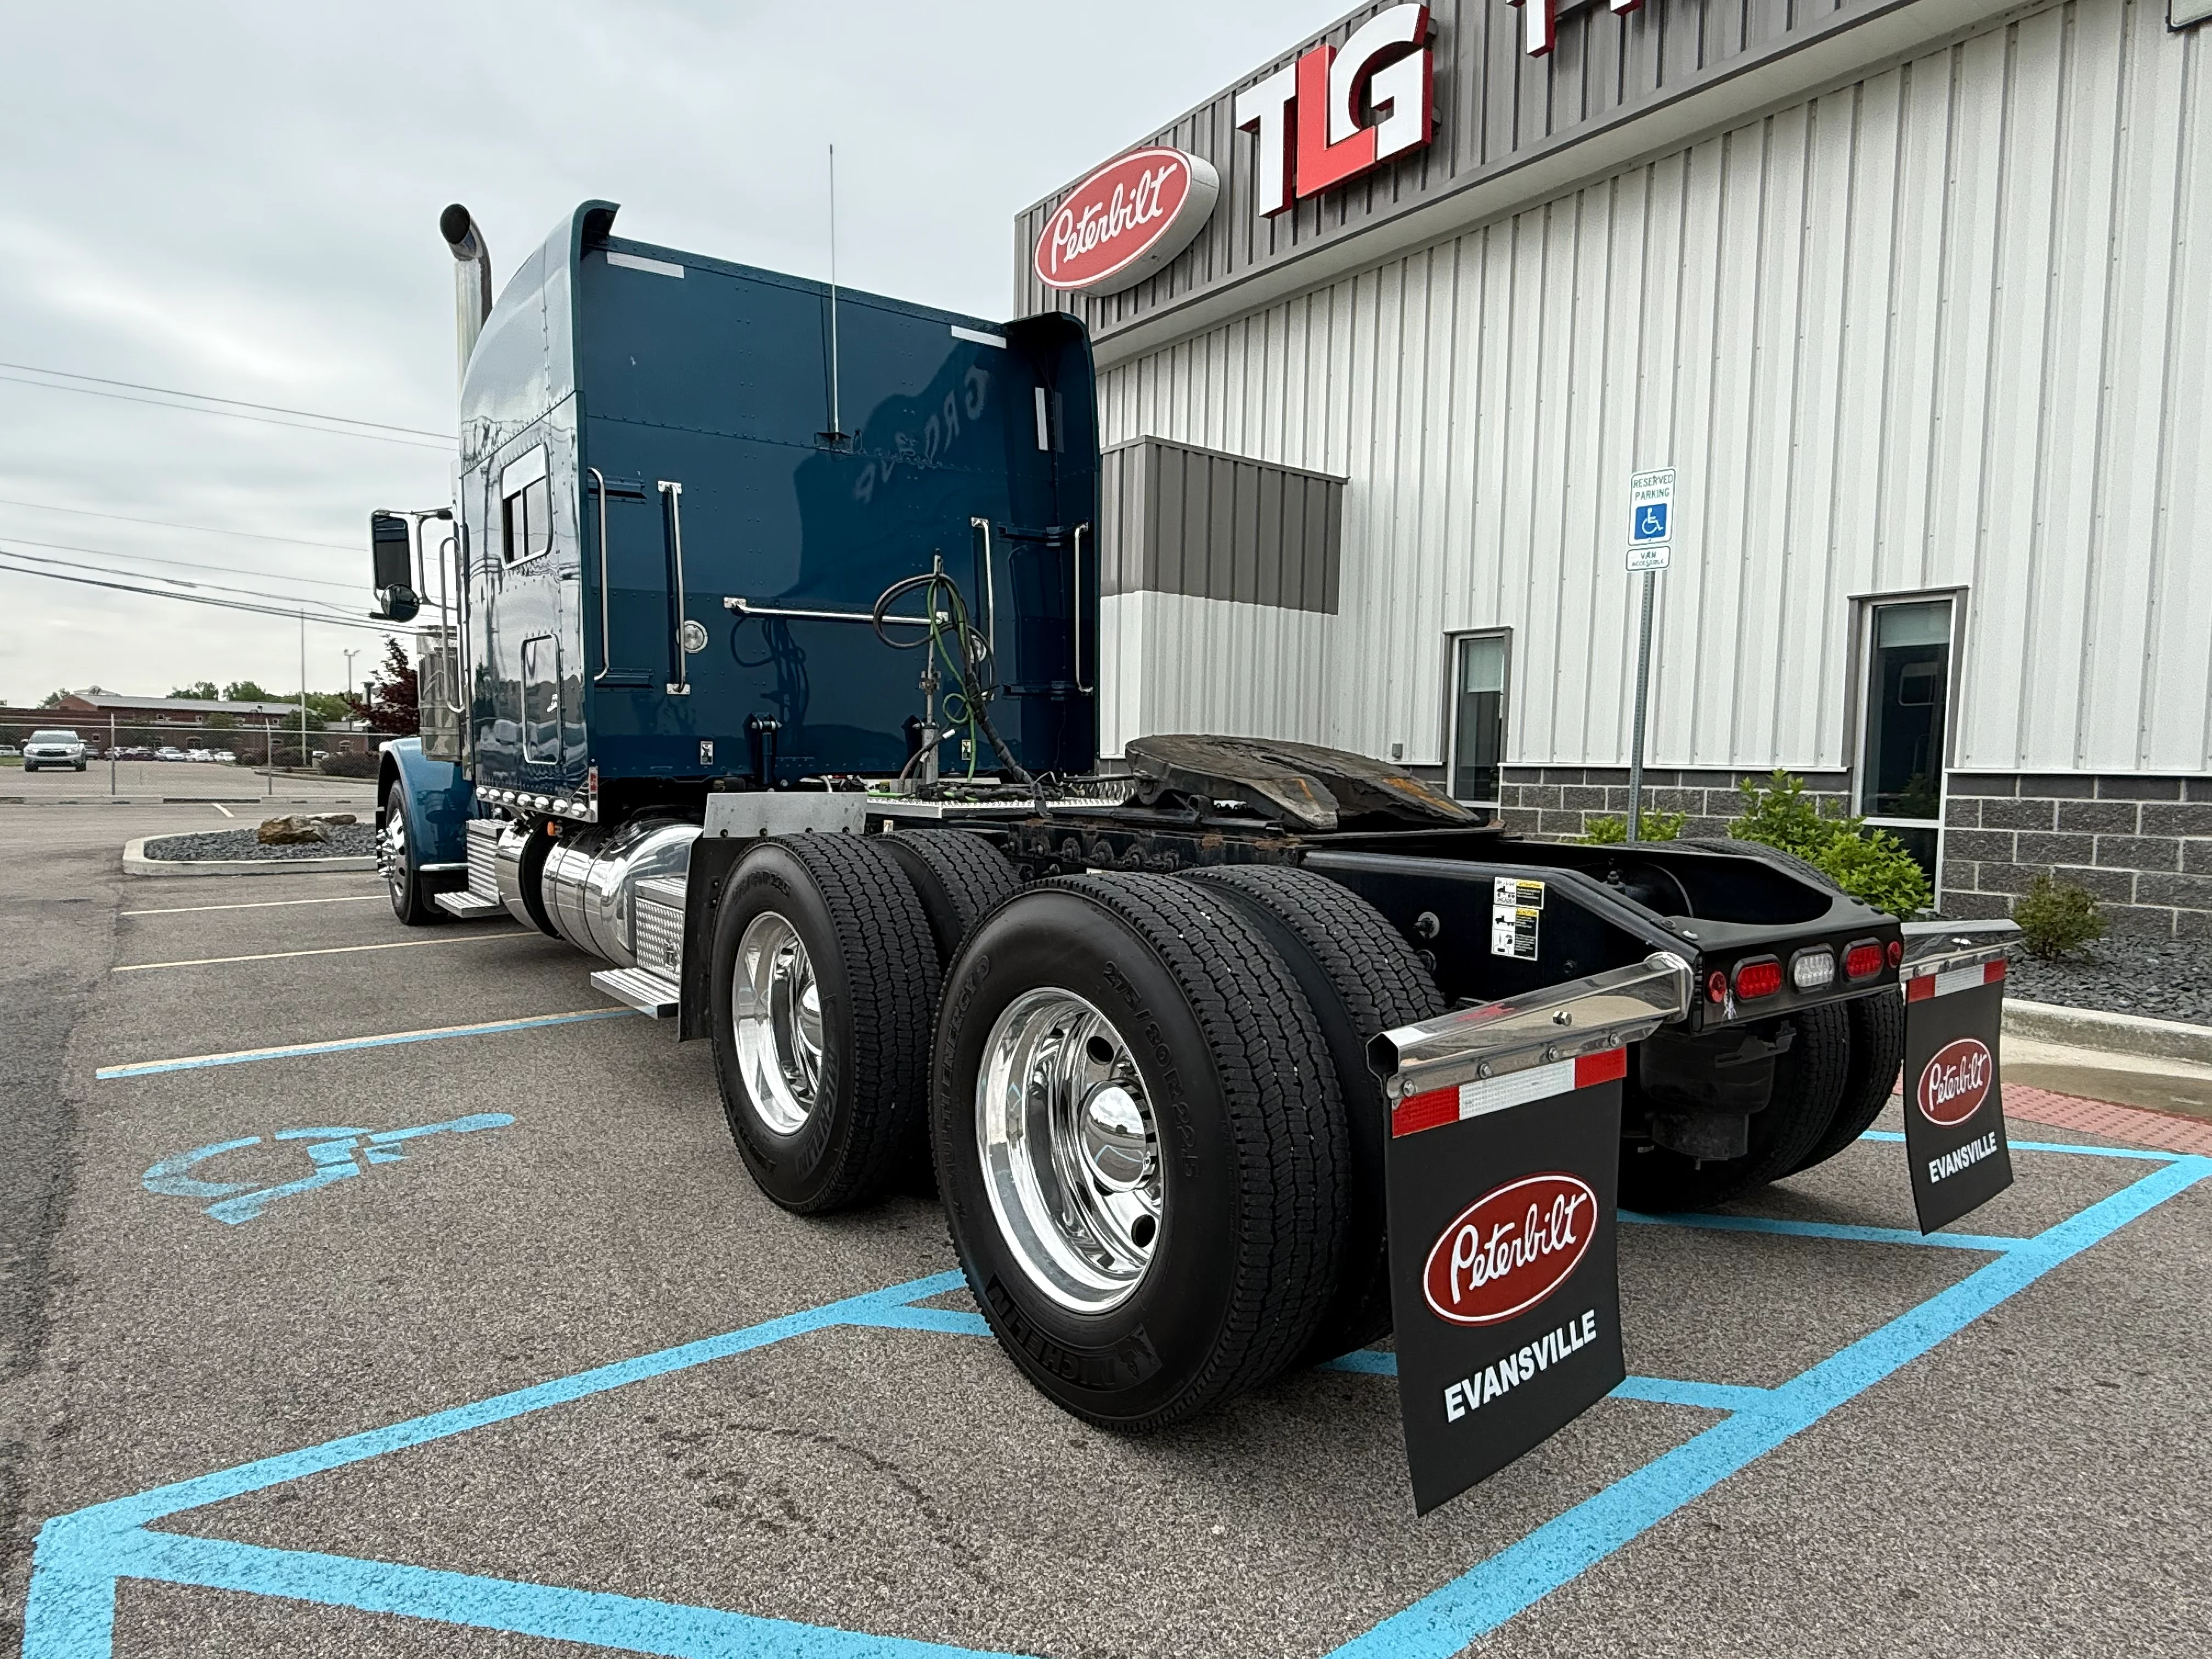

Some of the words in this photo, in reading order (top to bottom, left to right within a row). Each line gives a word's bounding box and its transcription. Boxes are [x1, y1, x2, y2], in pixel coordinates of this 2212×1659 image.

[1235, 3, 1431, 217] TLG
[1050, 163, 1177, 273] Peterbilt
[1633, 474, 1673, 488] RESERVED
[1635, 487, 1670, 501] PARKING
[1640, 551, 1657, 560] VAN
[1928, 1051, 1988, 1112] Peterbilt
[1928, 1131, 1997, 1184] EVANSVILLE
[1450, 1192, 1588, 1305] Peterbilt
[986, 1285, 1115, 1386] MICHELIN
[1443, 1309, 1596, 1423] EVANSVILLE
